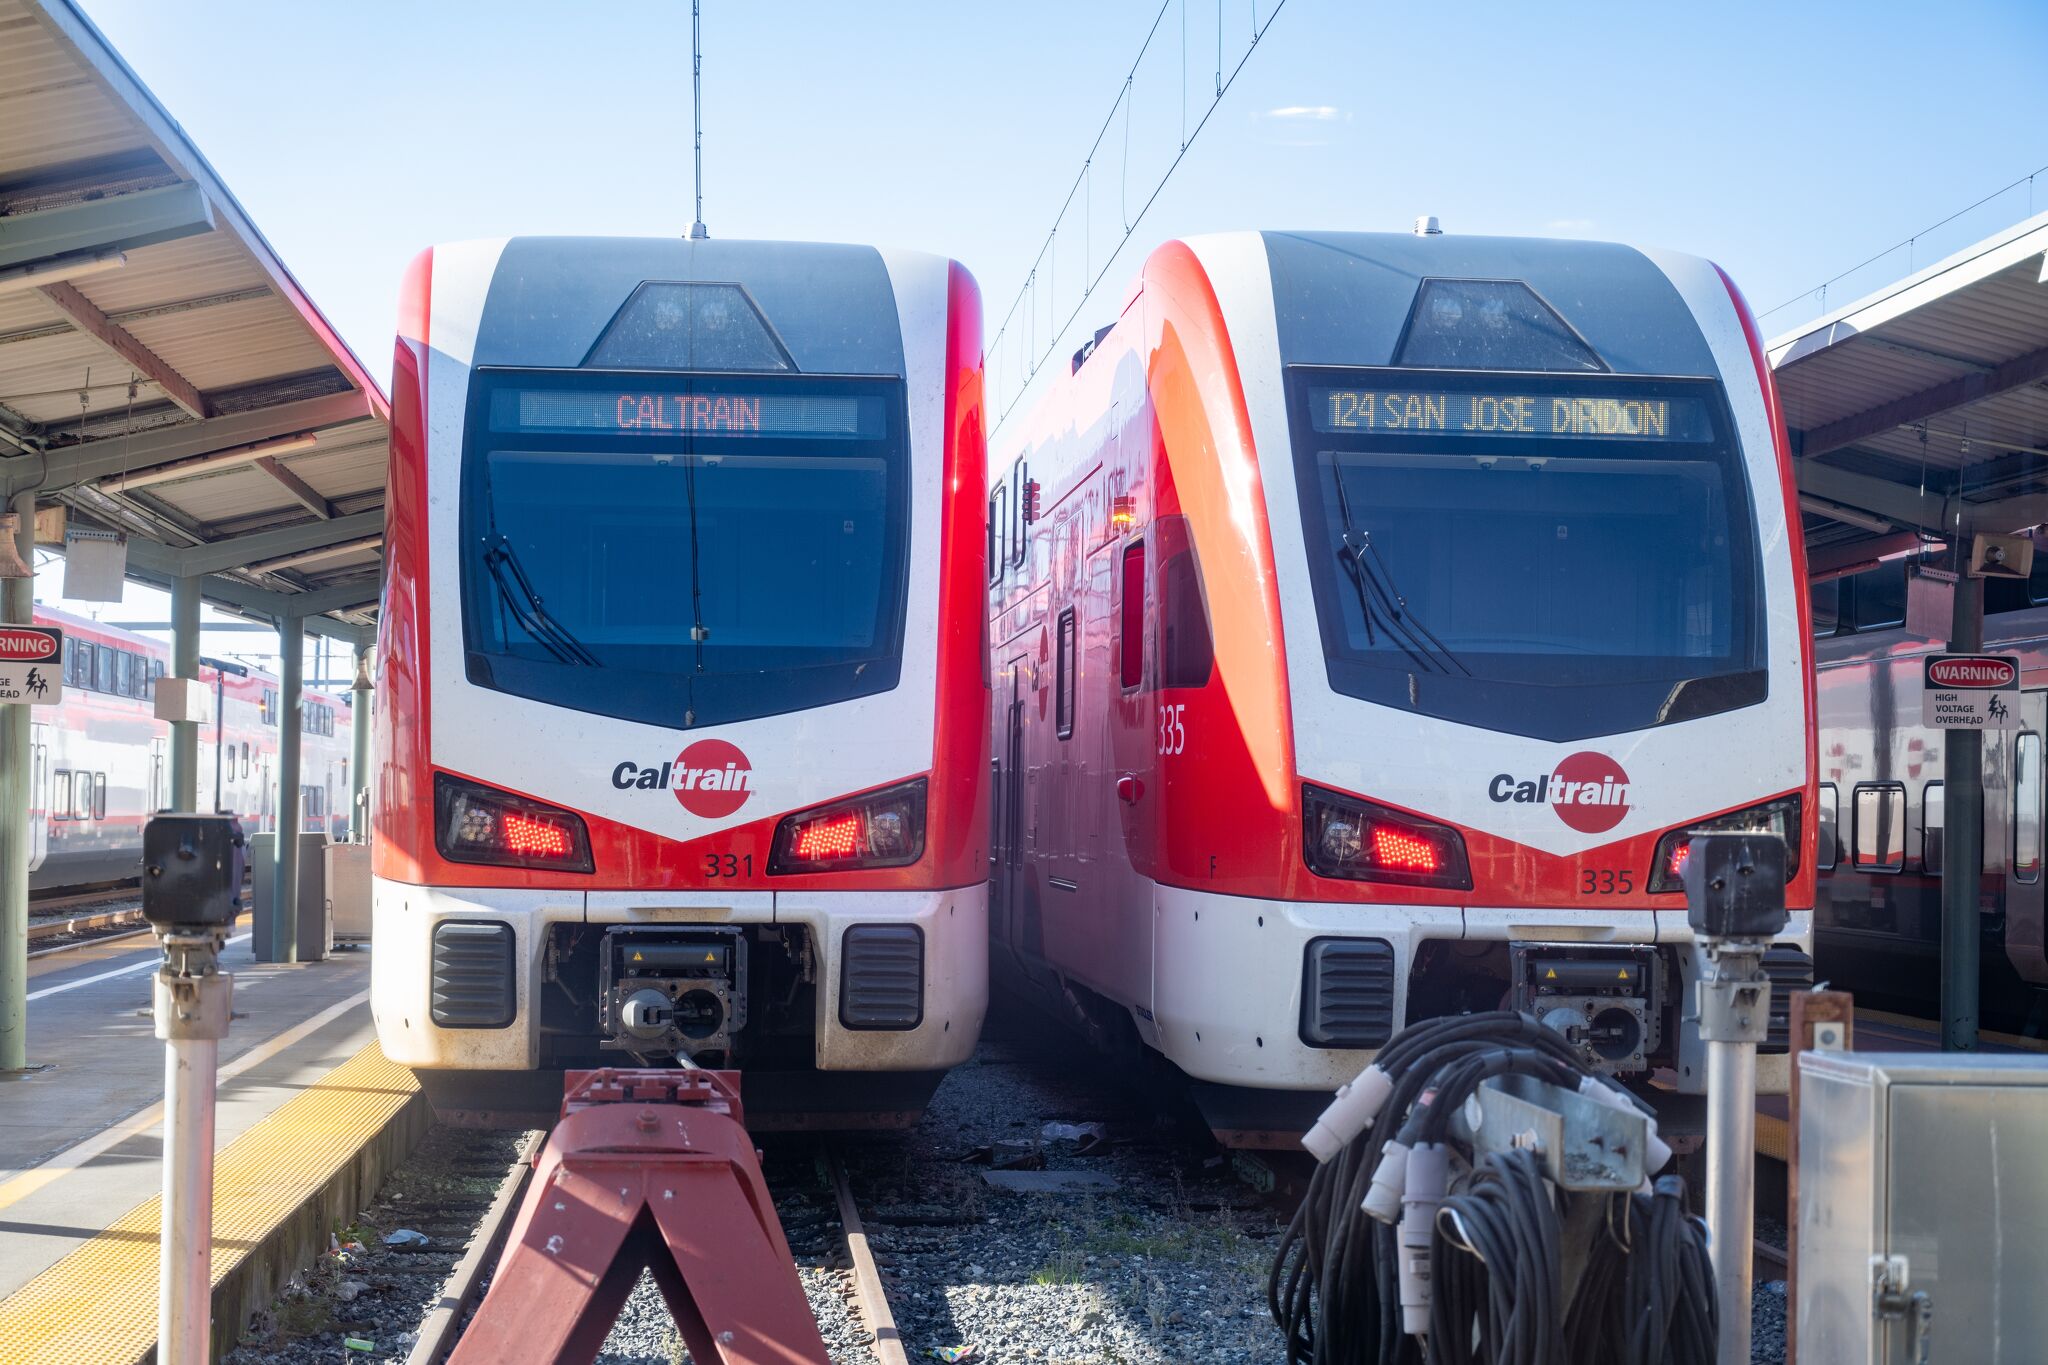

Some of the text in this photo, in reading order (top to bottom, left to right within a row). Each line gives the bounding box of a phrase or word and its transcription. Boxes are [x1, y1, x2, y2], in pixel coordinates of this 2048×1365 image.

[616, 395, 760, 431] CALTRAIN
[1330, 392, 1664, 436] 124 SAN JOSE DIRIDON
[1935, 666, 2009, 680] WARNING
[1935, 694, 1958, 702] HIGH
[1935, 705, 1975, 713] VOLTAGE
[1158, 704, 1185, 756] 335
[1935, 716, 1984, 724] OVERHEAD
[612, 761, 753, 791] Caltrain
[1489, 773, 1633, 806] Caltrain
[704, 853, 753, 878] 331
[1581, 869, 1633, 895] 335
